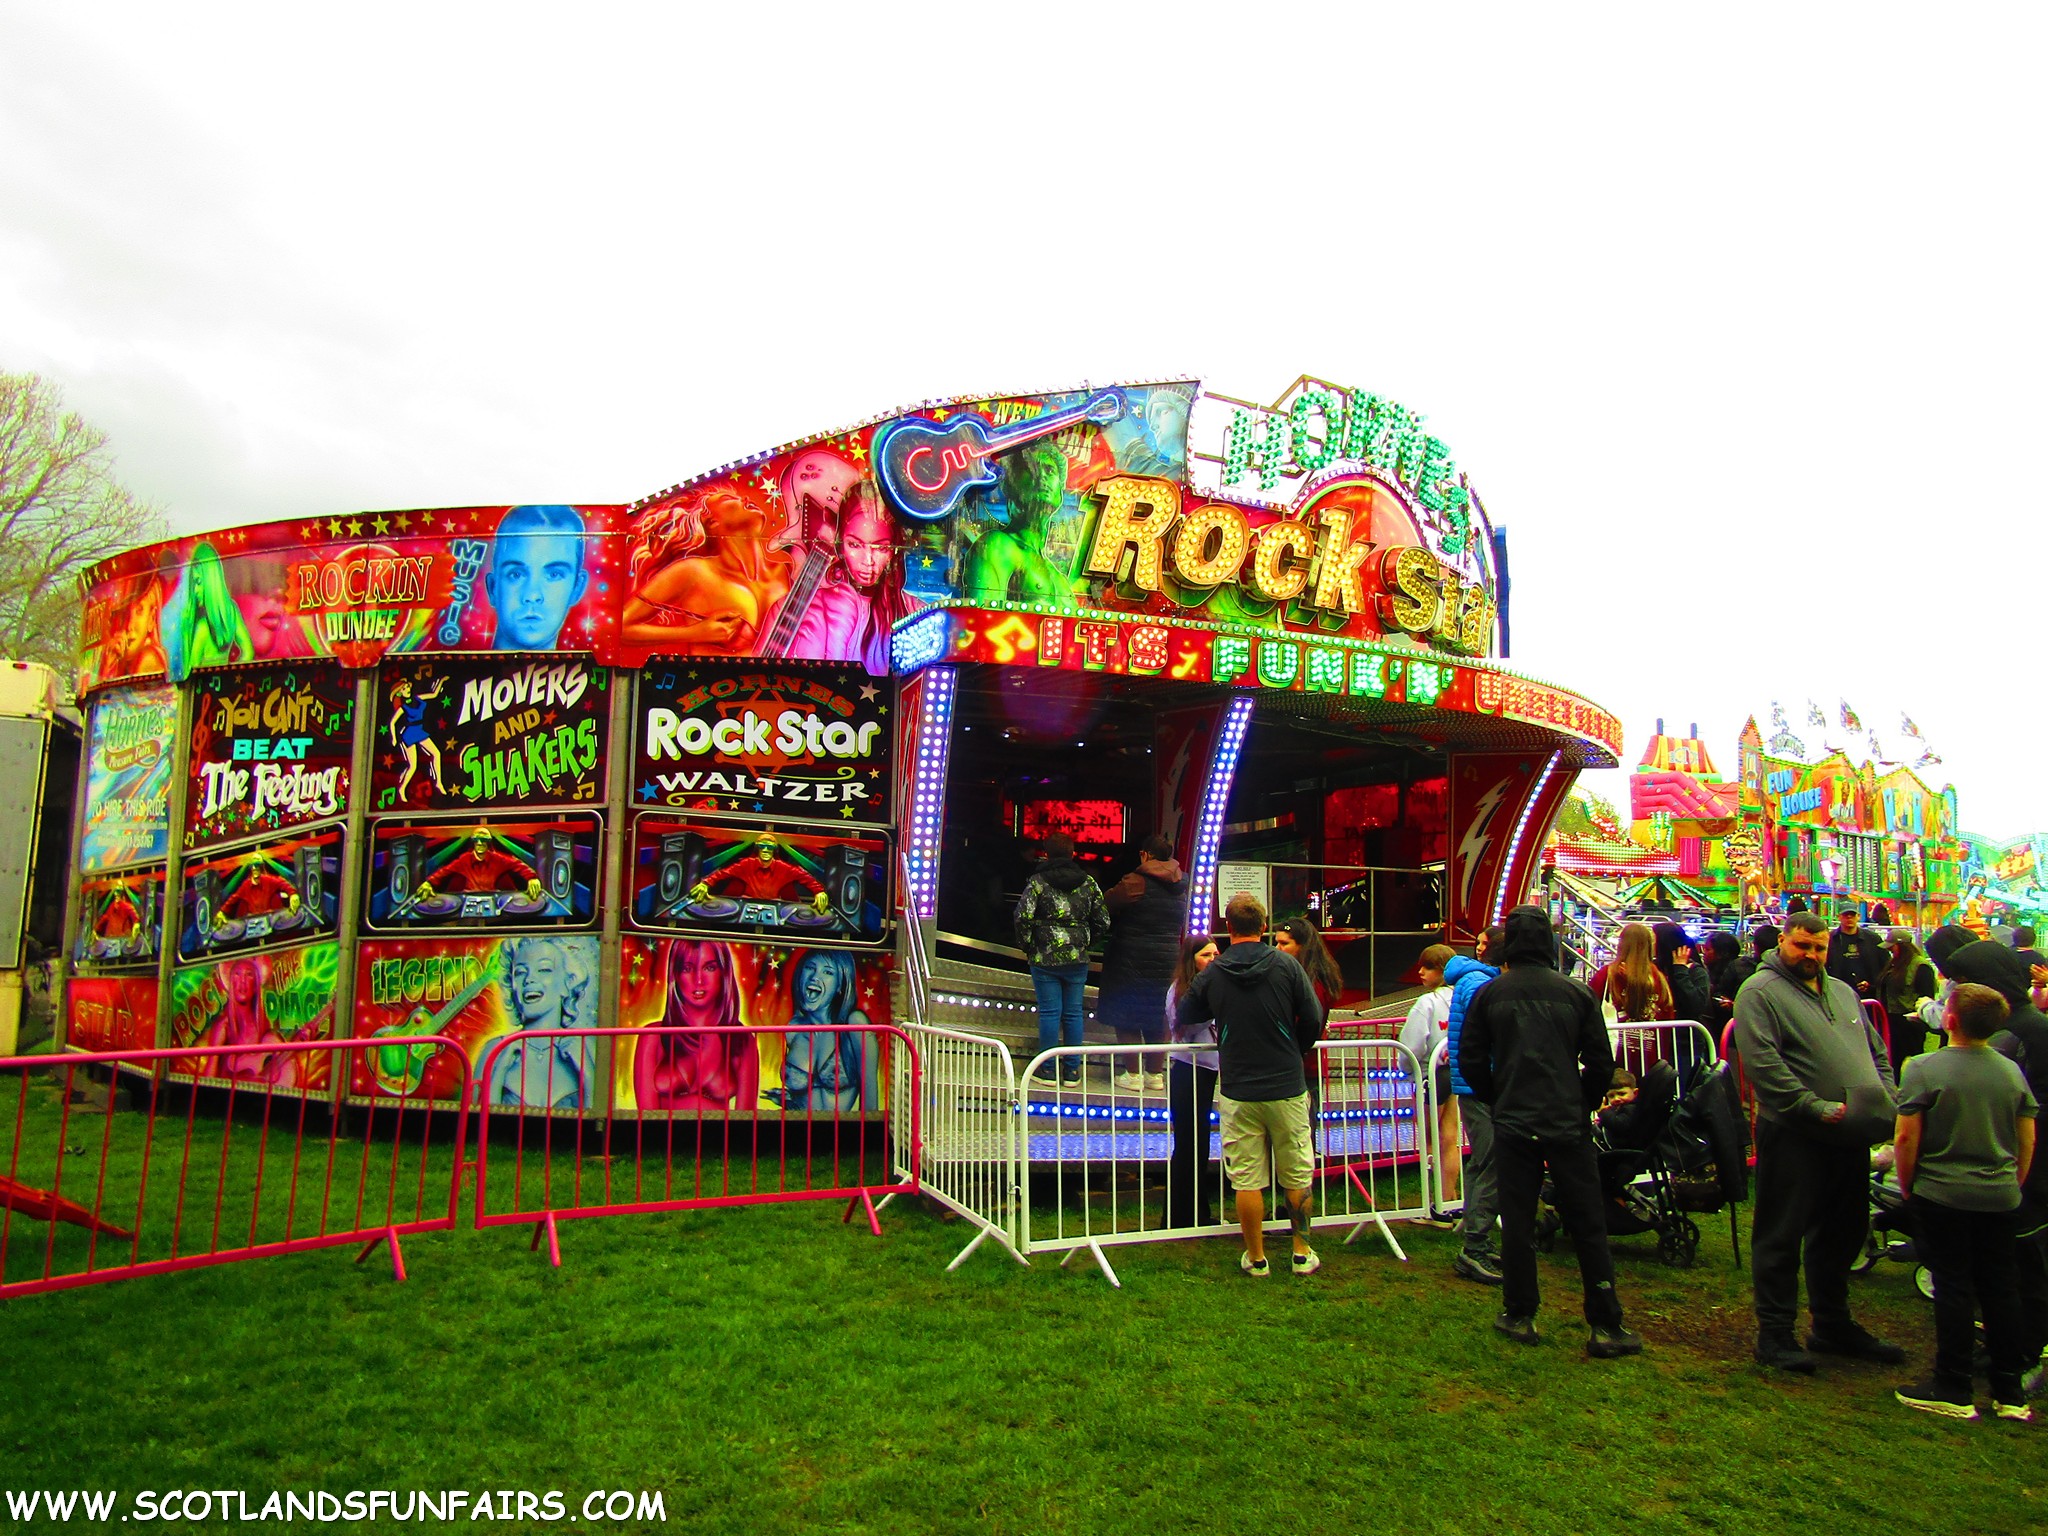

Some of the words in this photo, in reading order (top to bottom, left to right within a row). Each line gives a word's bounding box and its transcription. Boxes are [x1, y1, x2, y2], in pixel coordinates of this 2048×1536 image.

[991, 400, 1044, 426] NEW
[1222, 386, 1468, 556] HORNES
[1086, 474, 1378, 615] Rock
[298, 556, 434, 610] ROCKIN
[440, 538, 488, 646] MUSIC
[325, 609, 400, 643] DUNDEE
[1038, 617, 1169, 676] ITS
[218, 694, 261, 737] You
[457, 663, 588, 726] MOVERS
[676, 674, 856, 717] HORNES
[232, 738, 314, 760] BEAT
[495, 708, 541, 744] AND
[647, 708, 773, 760] Rock
[775, 711, 882, 758] Star
[460, 717, 598, 802] SHAKERS
[1766, 769, 1794, 795] FUN
[201, 760, 250, 819] The
[656, 772, 870, 802] WALTZER
[1780, 787, 1822, 818] HOUSE
[371, 956, 485, 1004] LEGEND
[75, 999, 135, 1050] STAR
